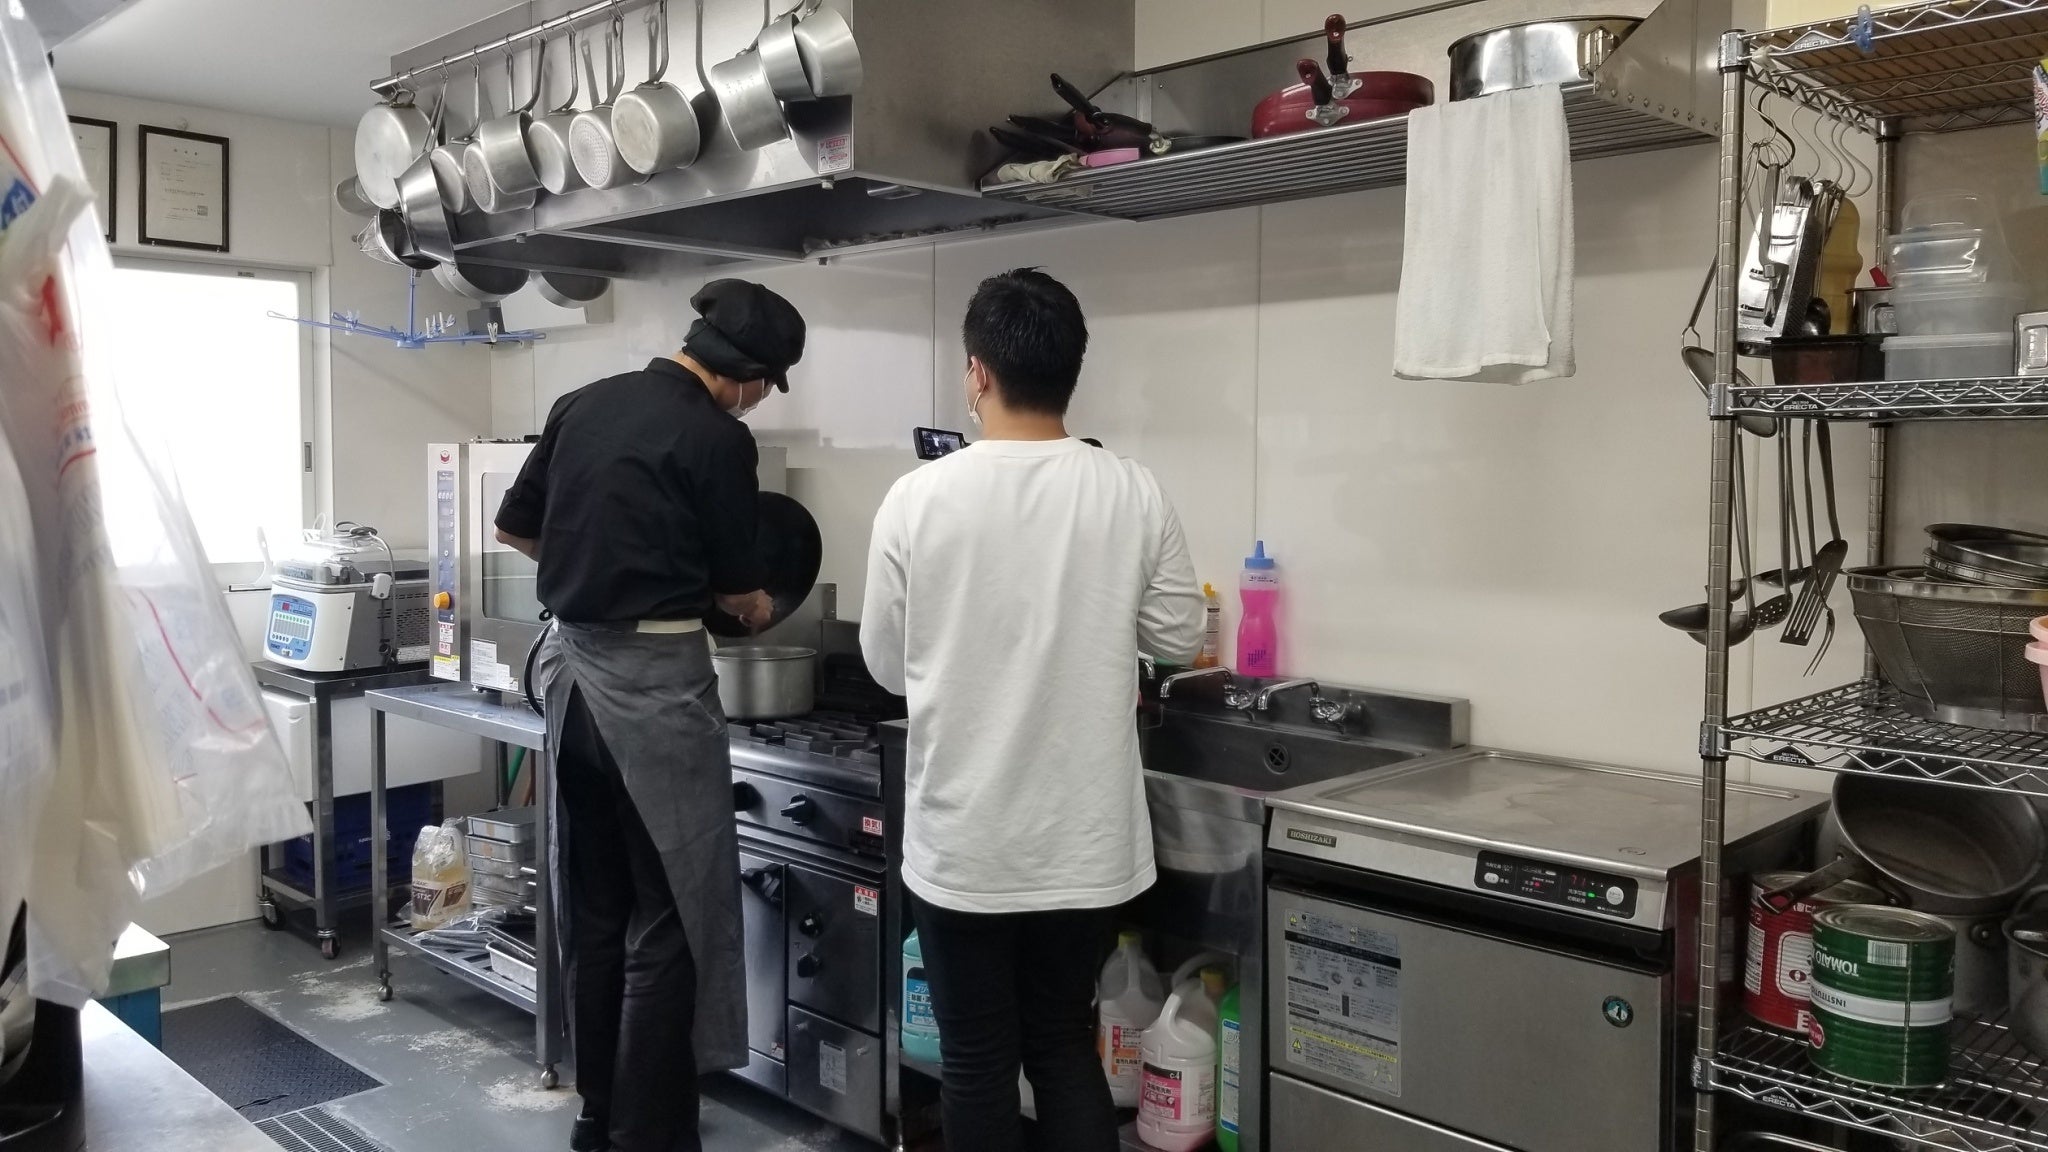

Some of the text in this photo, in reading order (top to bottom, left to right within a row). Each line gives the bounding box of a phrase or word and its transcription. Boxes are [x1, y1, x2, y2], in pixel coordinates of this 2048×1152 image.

[1773, 754, 1808, 765] ERECTA
[1290, 831, 1332, 845] HOSHIZAKI
[1815, 950, 1860, 977] TOMATO
[1762, 1095, 1796, 1109] ERECTA
